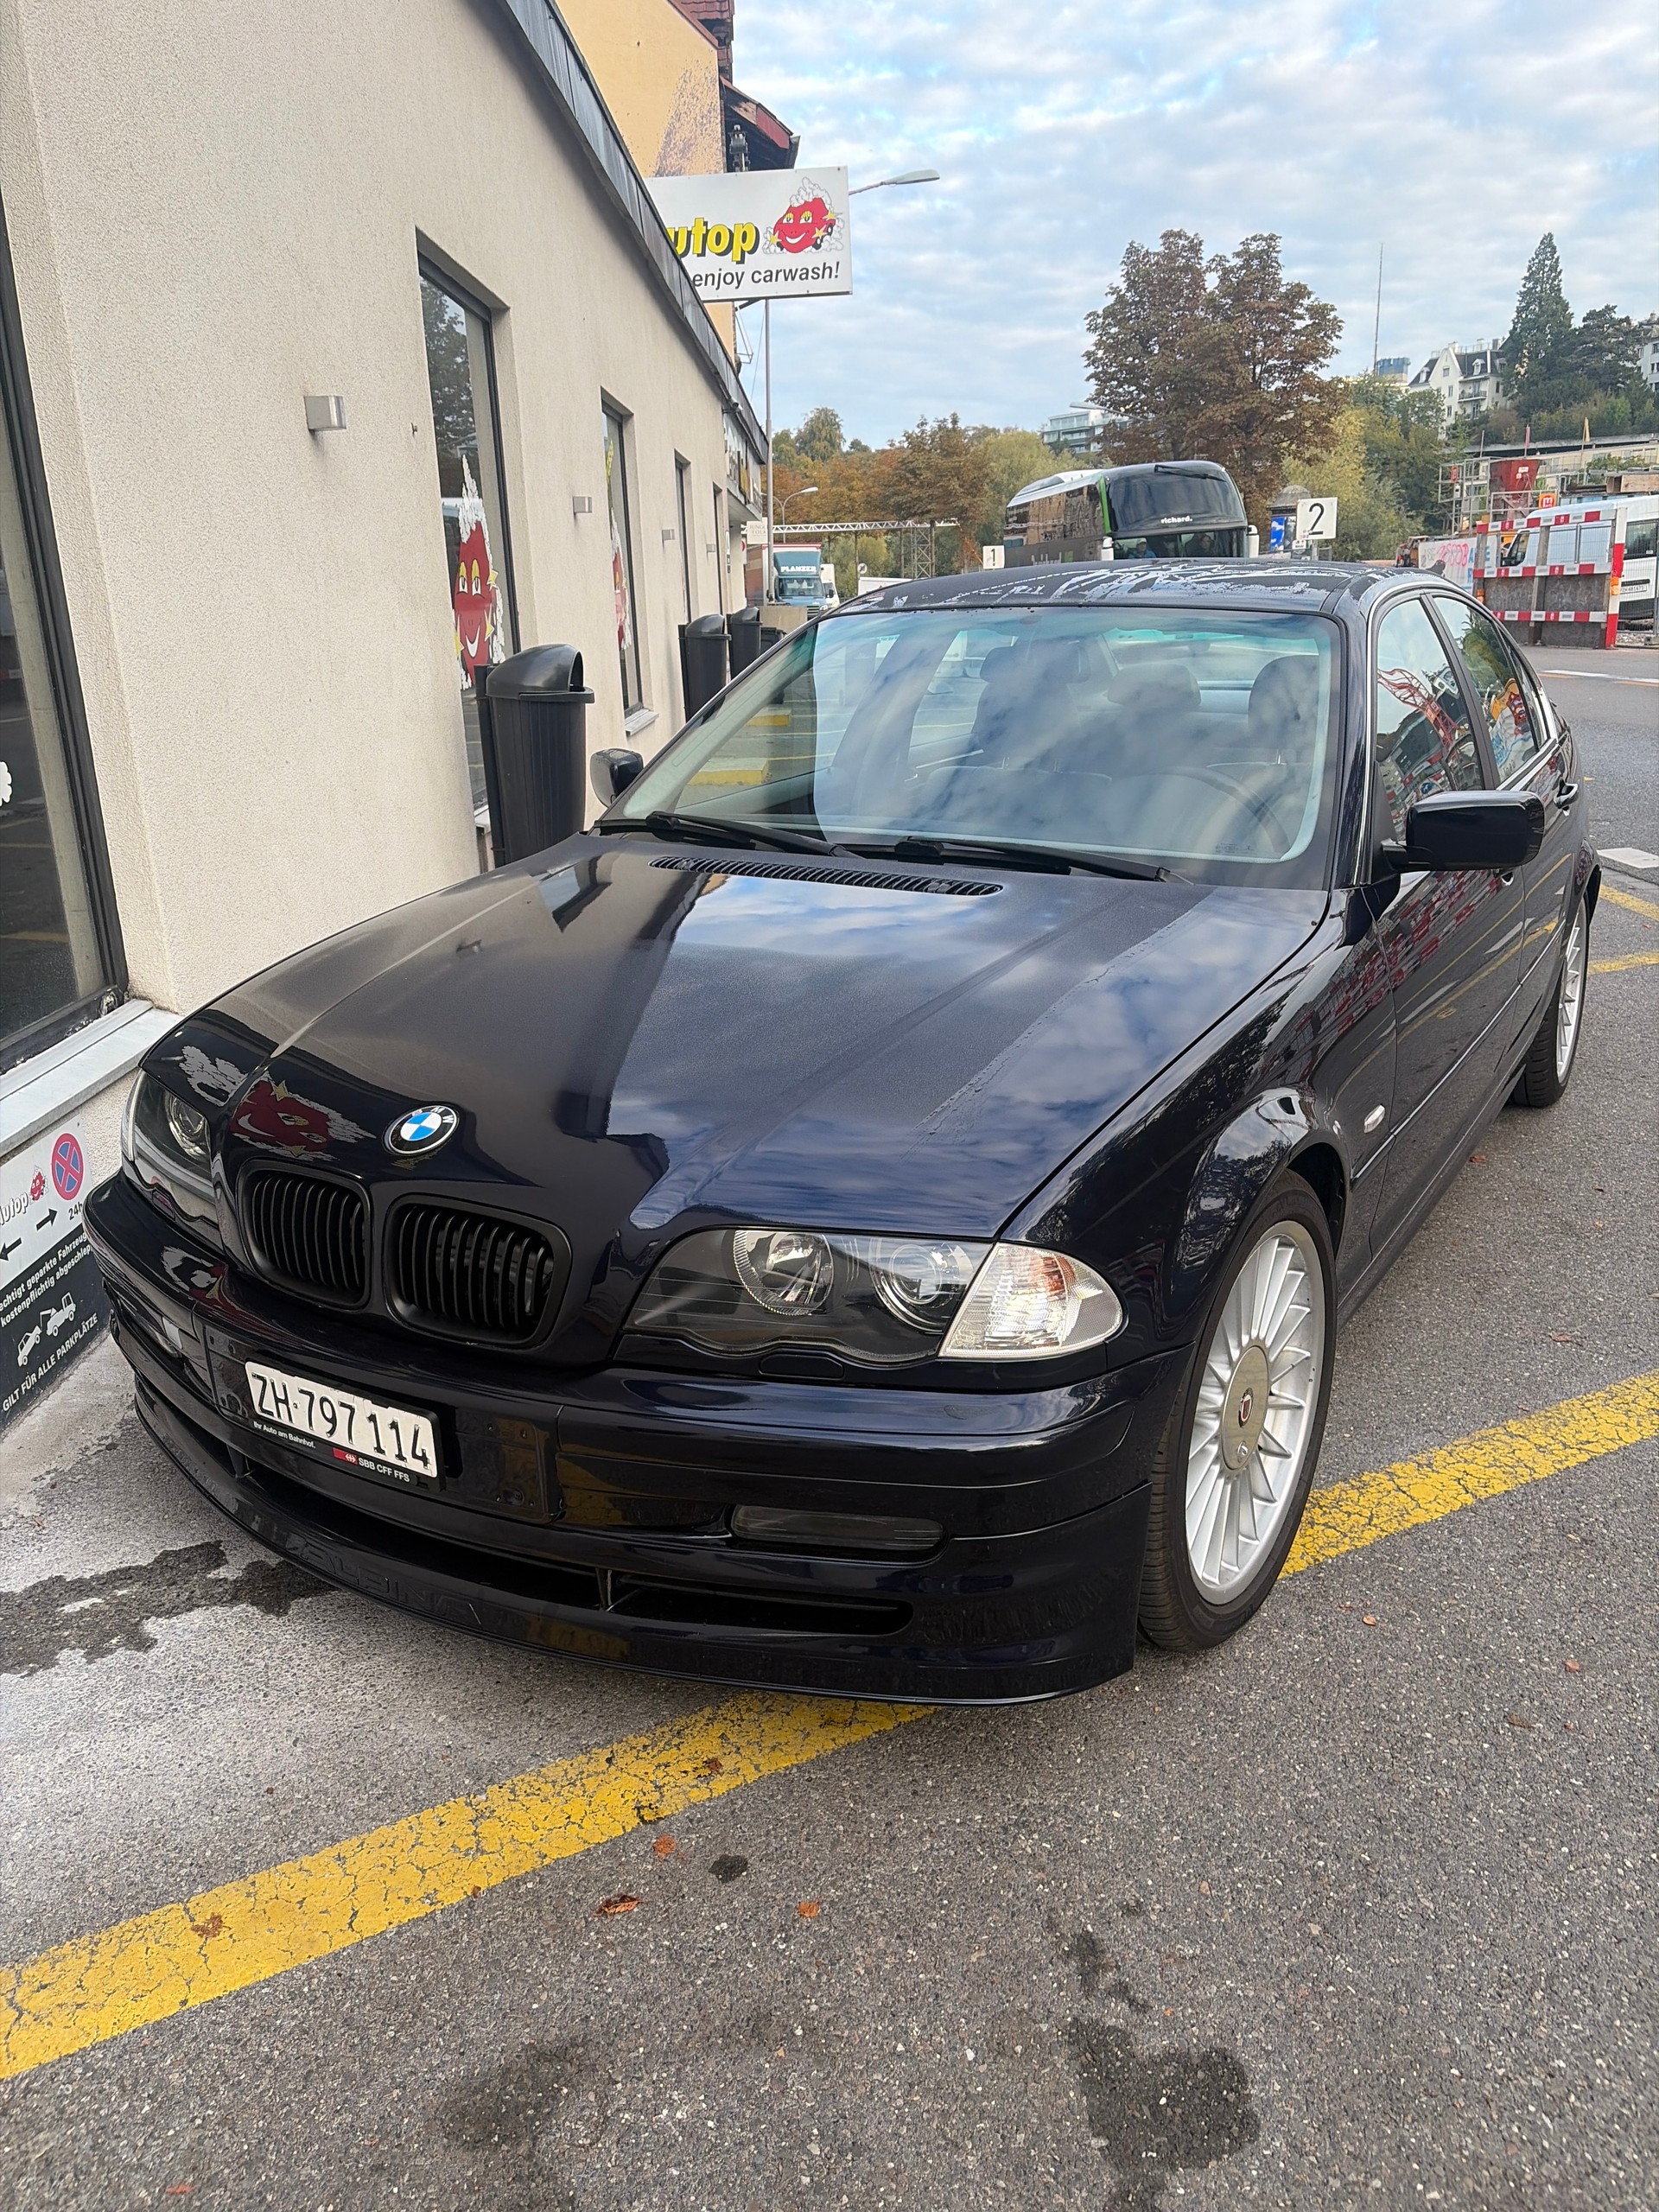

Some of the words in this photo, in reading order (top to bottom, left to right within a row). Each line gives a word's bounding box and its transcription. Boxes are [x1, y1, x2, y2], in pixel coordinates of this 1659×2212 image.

[666, 218, 760, 264] utop
[692, 268, 745, 290] enjoy
[751, 261, 840, 285] carwash!
[1308, 502, 1325, 536] 2
[0, 1282, 26, 1311] echtigt
[26, 1256, 57, 1290] geparkte
[57, 1232, 87, 1262] Fahrzeug
[1, 1275, 55, 1328] kostenpflichtig
[55, 1243, 92, 1280] abgeschlep
[3, 1388, 20, 1412] GILT
[21, 1372, 37, 1395] FÜR
[38, 1354, 56, 1380] ALLE
[56, 1313, 99, 1361] PARKPLÄTZE
[263, 1424, 277, 1435] Auto
[278, 1431, 288, 1440] am
[358, 1457, 376, 1471] SBB
[376, 1464, 392, 1477] CFF
[394, 1471, 410, 1483] FFS
